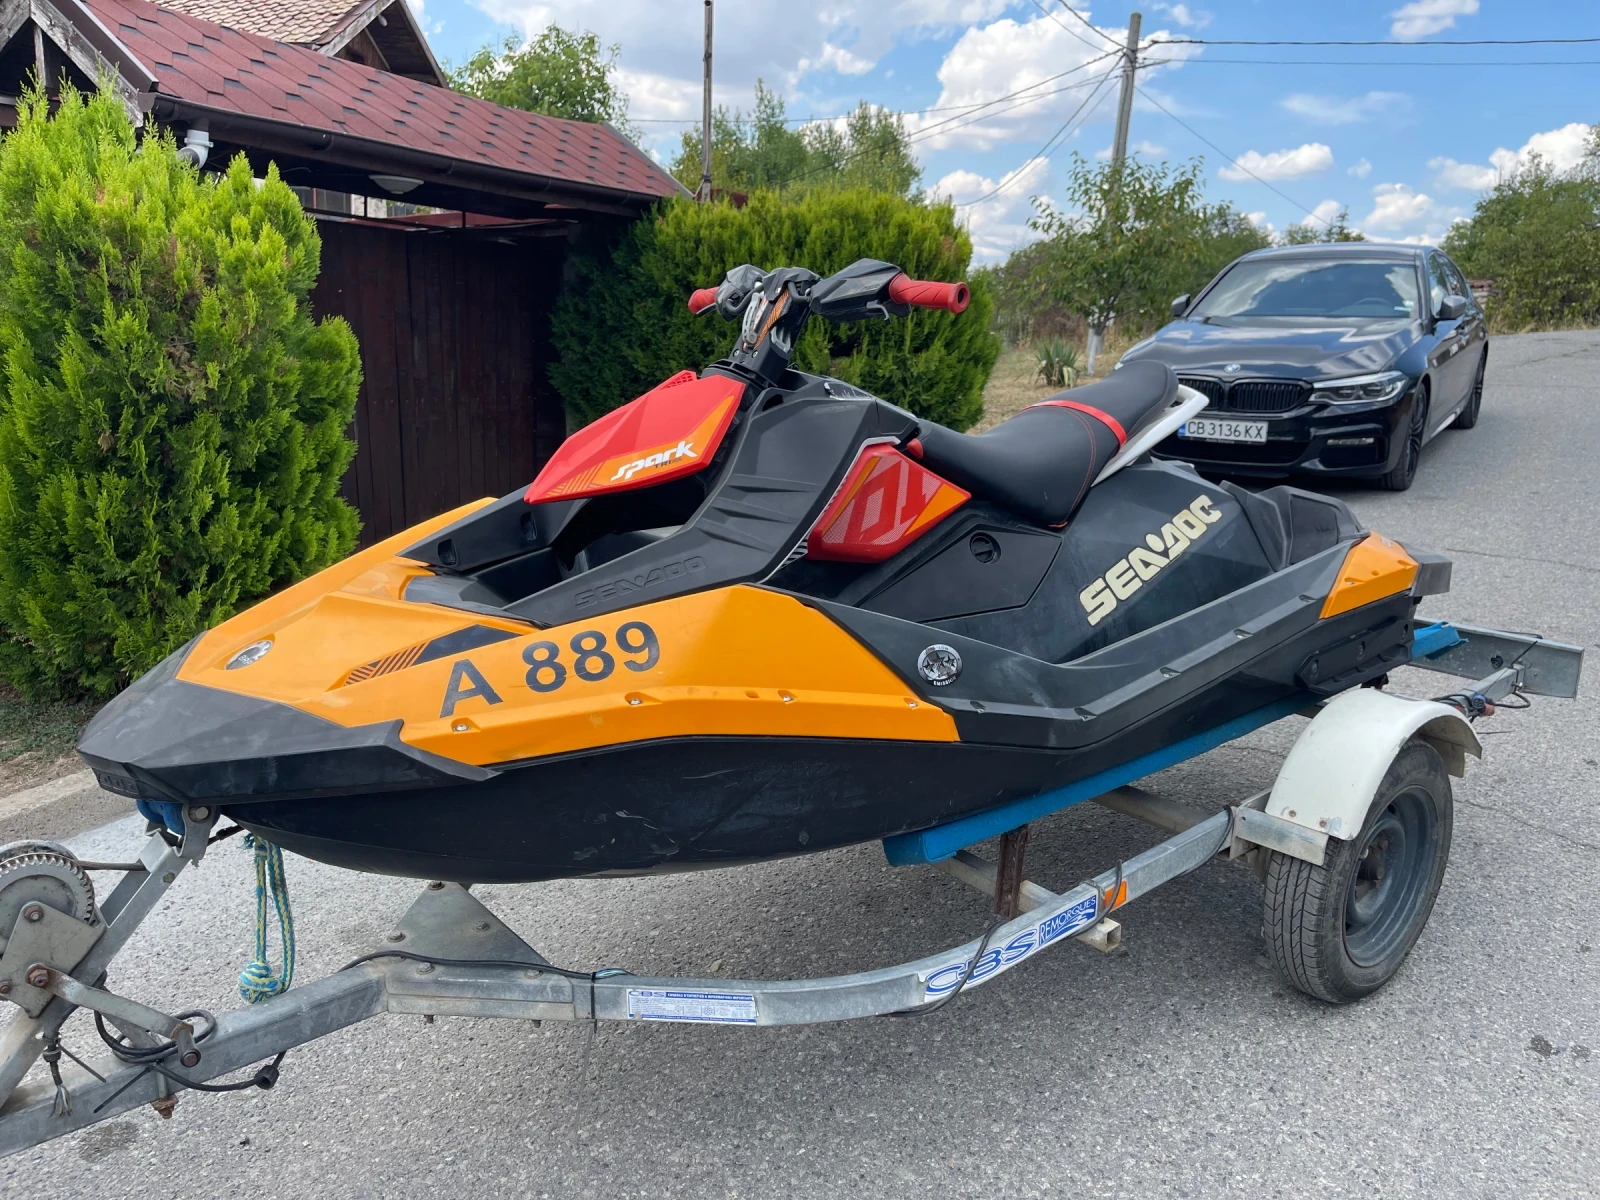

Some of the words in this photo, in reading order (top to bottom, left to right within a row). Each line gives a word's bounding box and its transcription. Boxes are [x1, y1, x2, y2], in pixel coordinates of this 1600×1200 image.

[1187, 421, 1205, 435] CB
[1207, 422, 1241, 437] 3136
[1244, 424, 1264, 439] KX
[439, 658, 504, 719] A
[521, 620, 661, 693] 889
[925, 928, 1038, 996] CBS
[1039, 895, 1097, 942] REMORQUES
